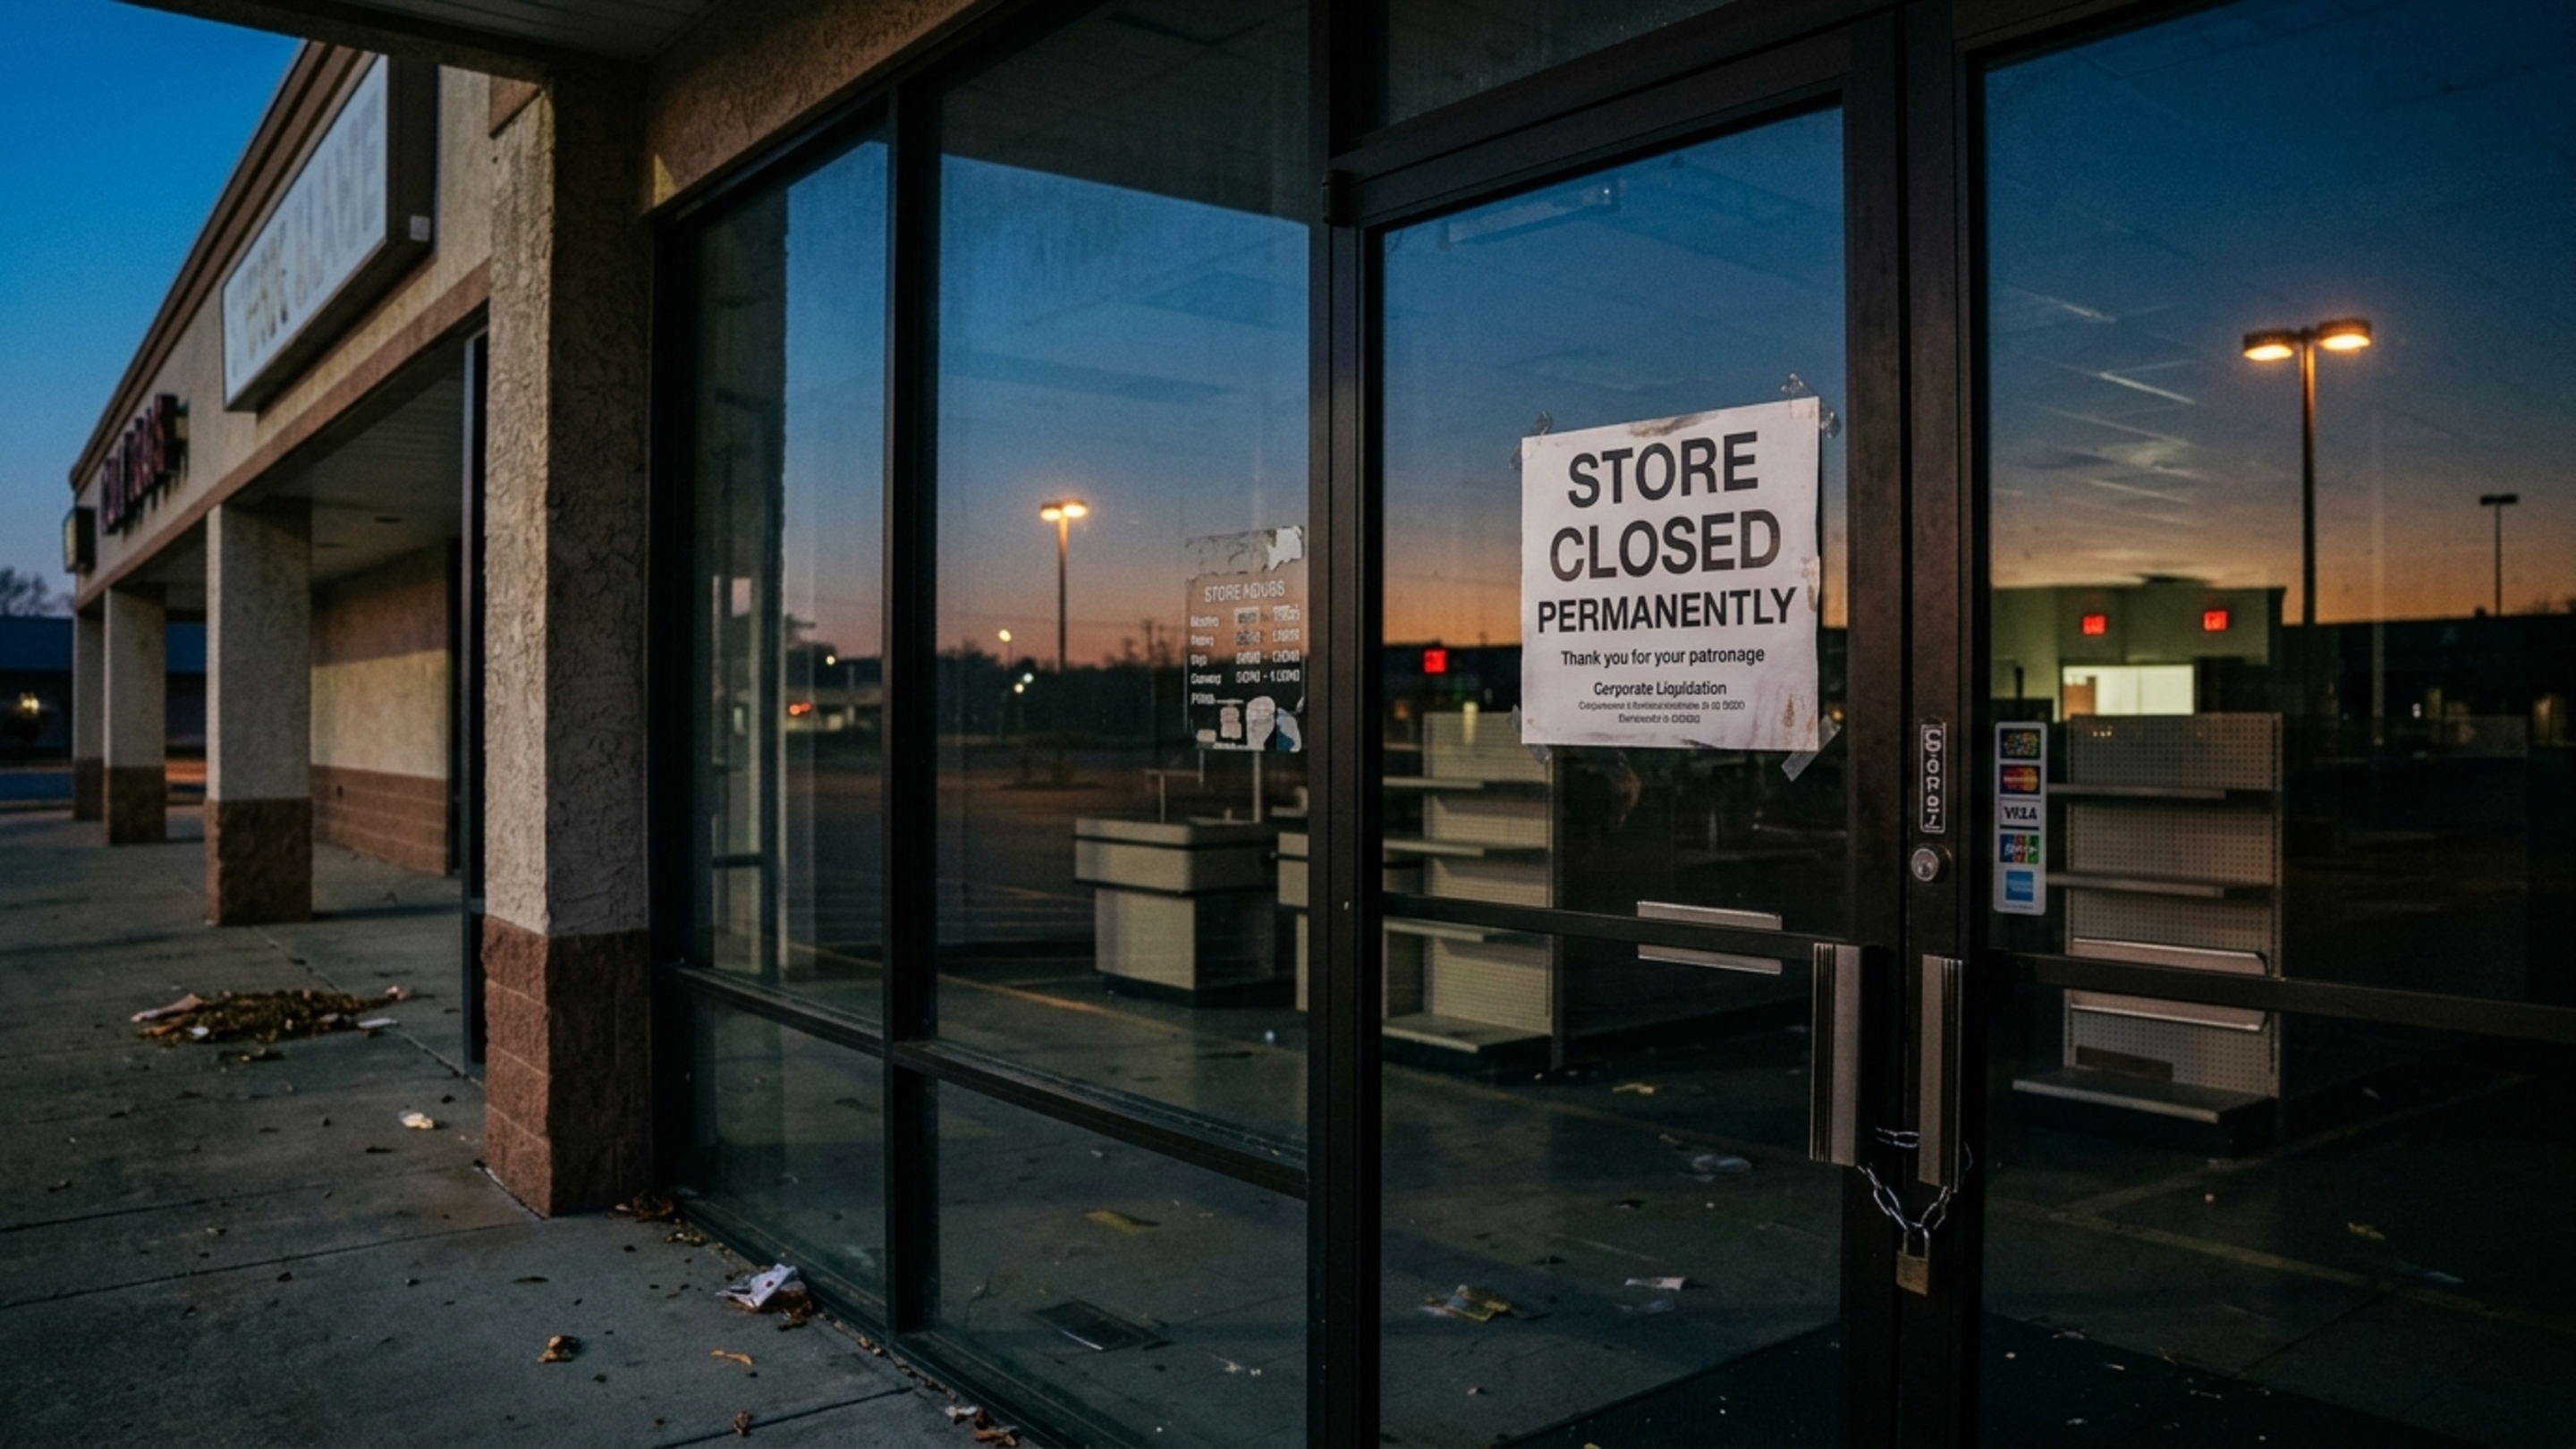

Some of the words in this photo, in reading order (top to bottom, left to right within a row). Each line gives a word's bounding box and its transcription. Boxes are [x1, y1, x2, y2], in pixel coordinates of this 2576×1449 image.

[1567, 431, 1758, 508] STORE
[1549, 509, 1782, 582] CLOSED
[1204, 584, 1241, 602] STORE
[1538, 587, 1797, 633] PERMANENTLY
[1561, 650, 1601, 665] Thank
[1604, 653, 1629, 668] you
[1631, 649, 1652, 665] for
[1654, 650, 1686, 666] your
[1689, 648, 1766, 666] patronage
